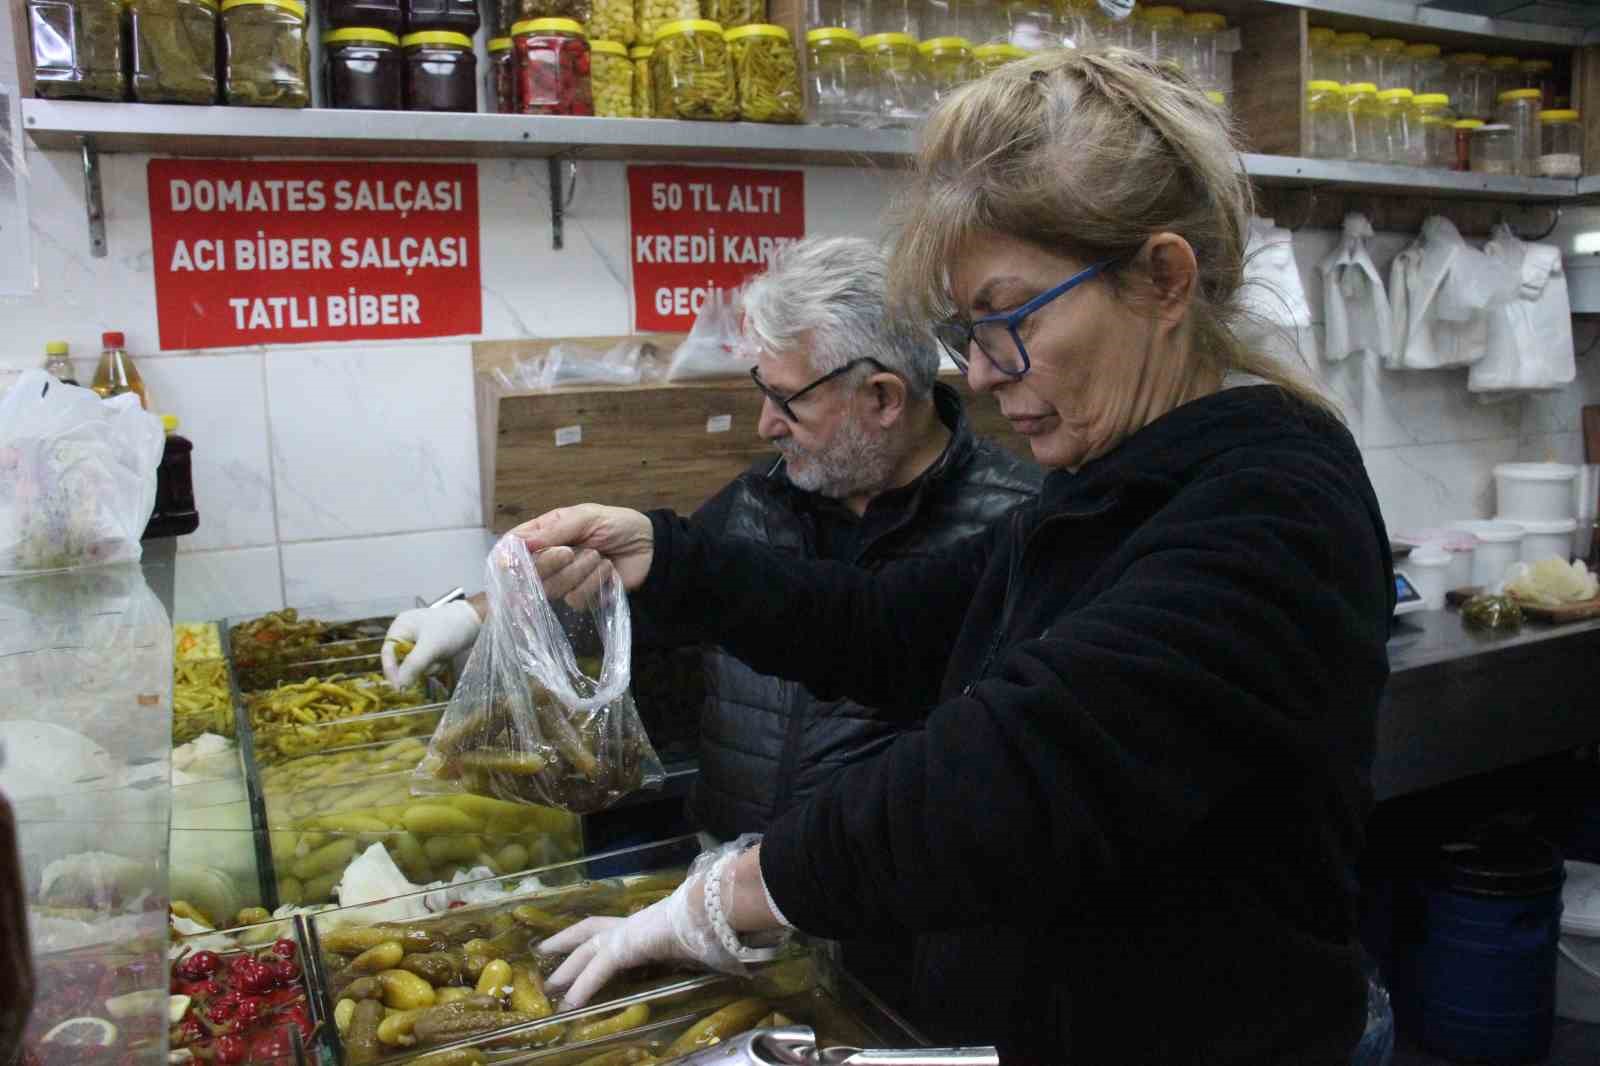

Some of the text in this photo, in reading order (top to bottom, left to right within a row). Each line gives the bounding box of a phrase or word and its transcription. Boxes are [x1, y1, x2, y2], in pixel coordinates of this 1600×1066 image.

[169, 179, 462, 218] DOMATES SALÇASI
[651, 182, 781, 214] 50 TL ALTI
[170, 230, 468, 276] ACI BİBER SALÇASI
[635, 227, 716, 264] KREDİ
[229, 286, 421, 330] TATLI BİBER
